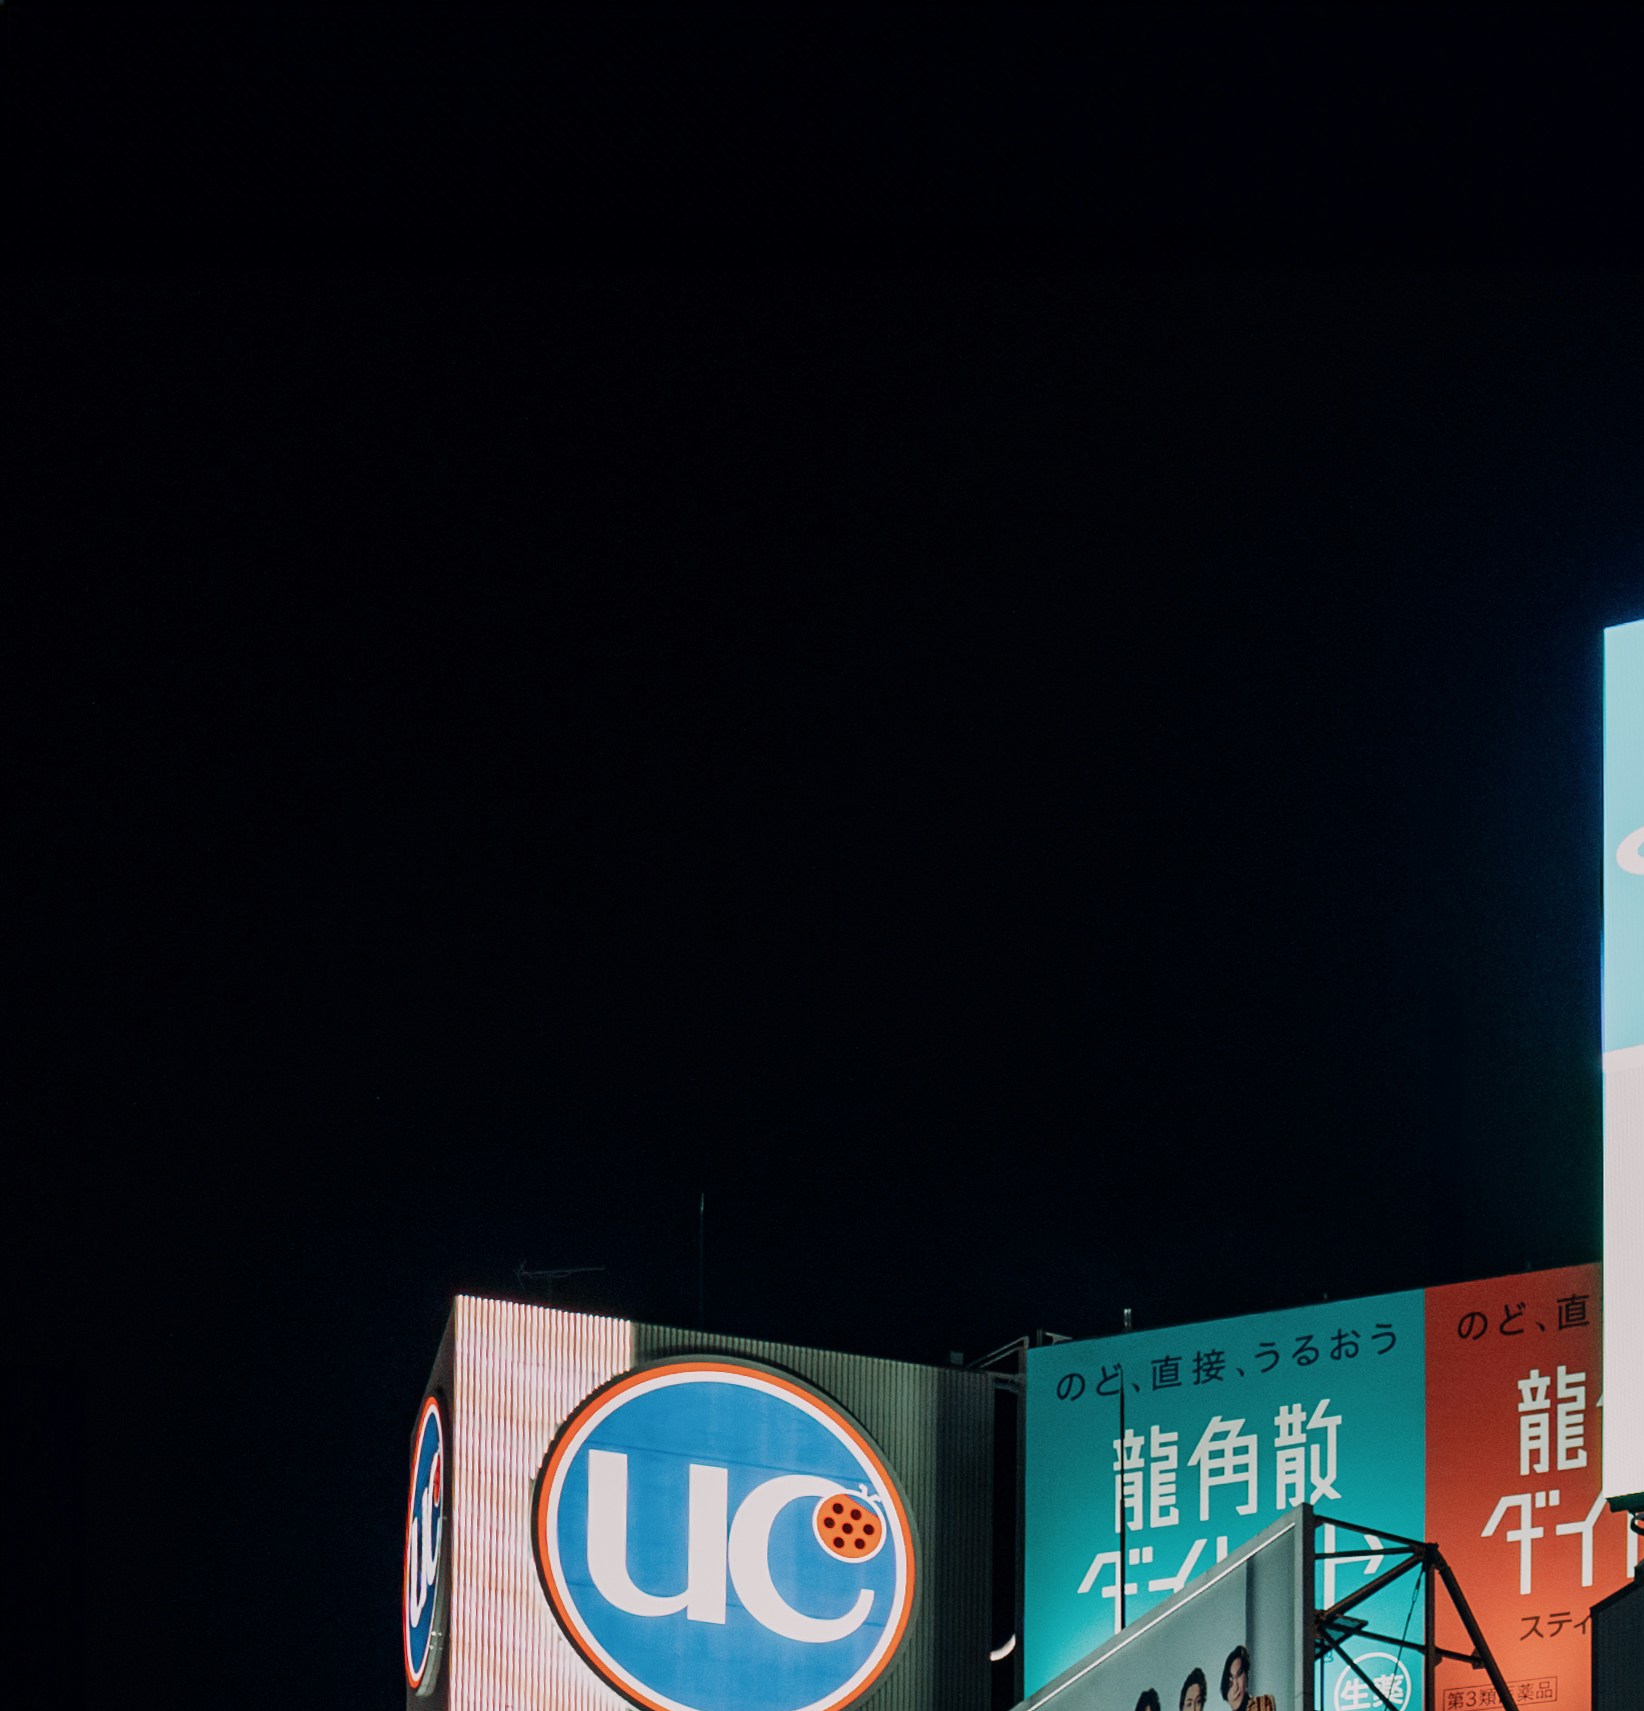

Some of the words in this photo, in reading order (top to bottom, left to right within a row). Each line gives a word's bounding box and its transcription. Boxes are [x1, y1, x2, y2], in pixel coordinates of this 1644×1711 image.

[1056, 1323, 1397, 1402] のど、直接、うるおう
[1518, 1366, 1603, 1475] 龍
[1113, 1398, 1342, 1533] 龍角散
[587, 1449, 875, 1643] UC
